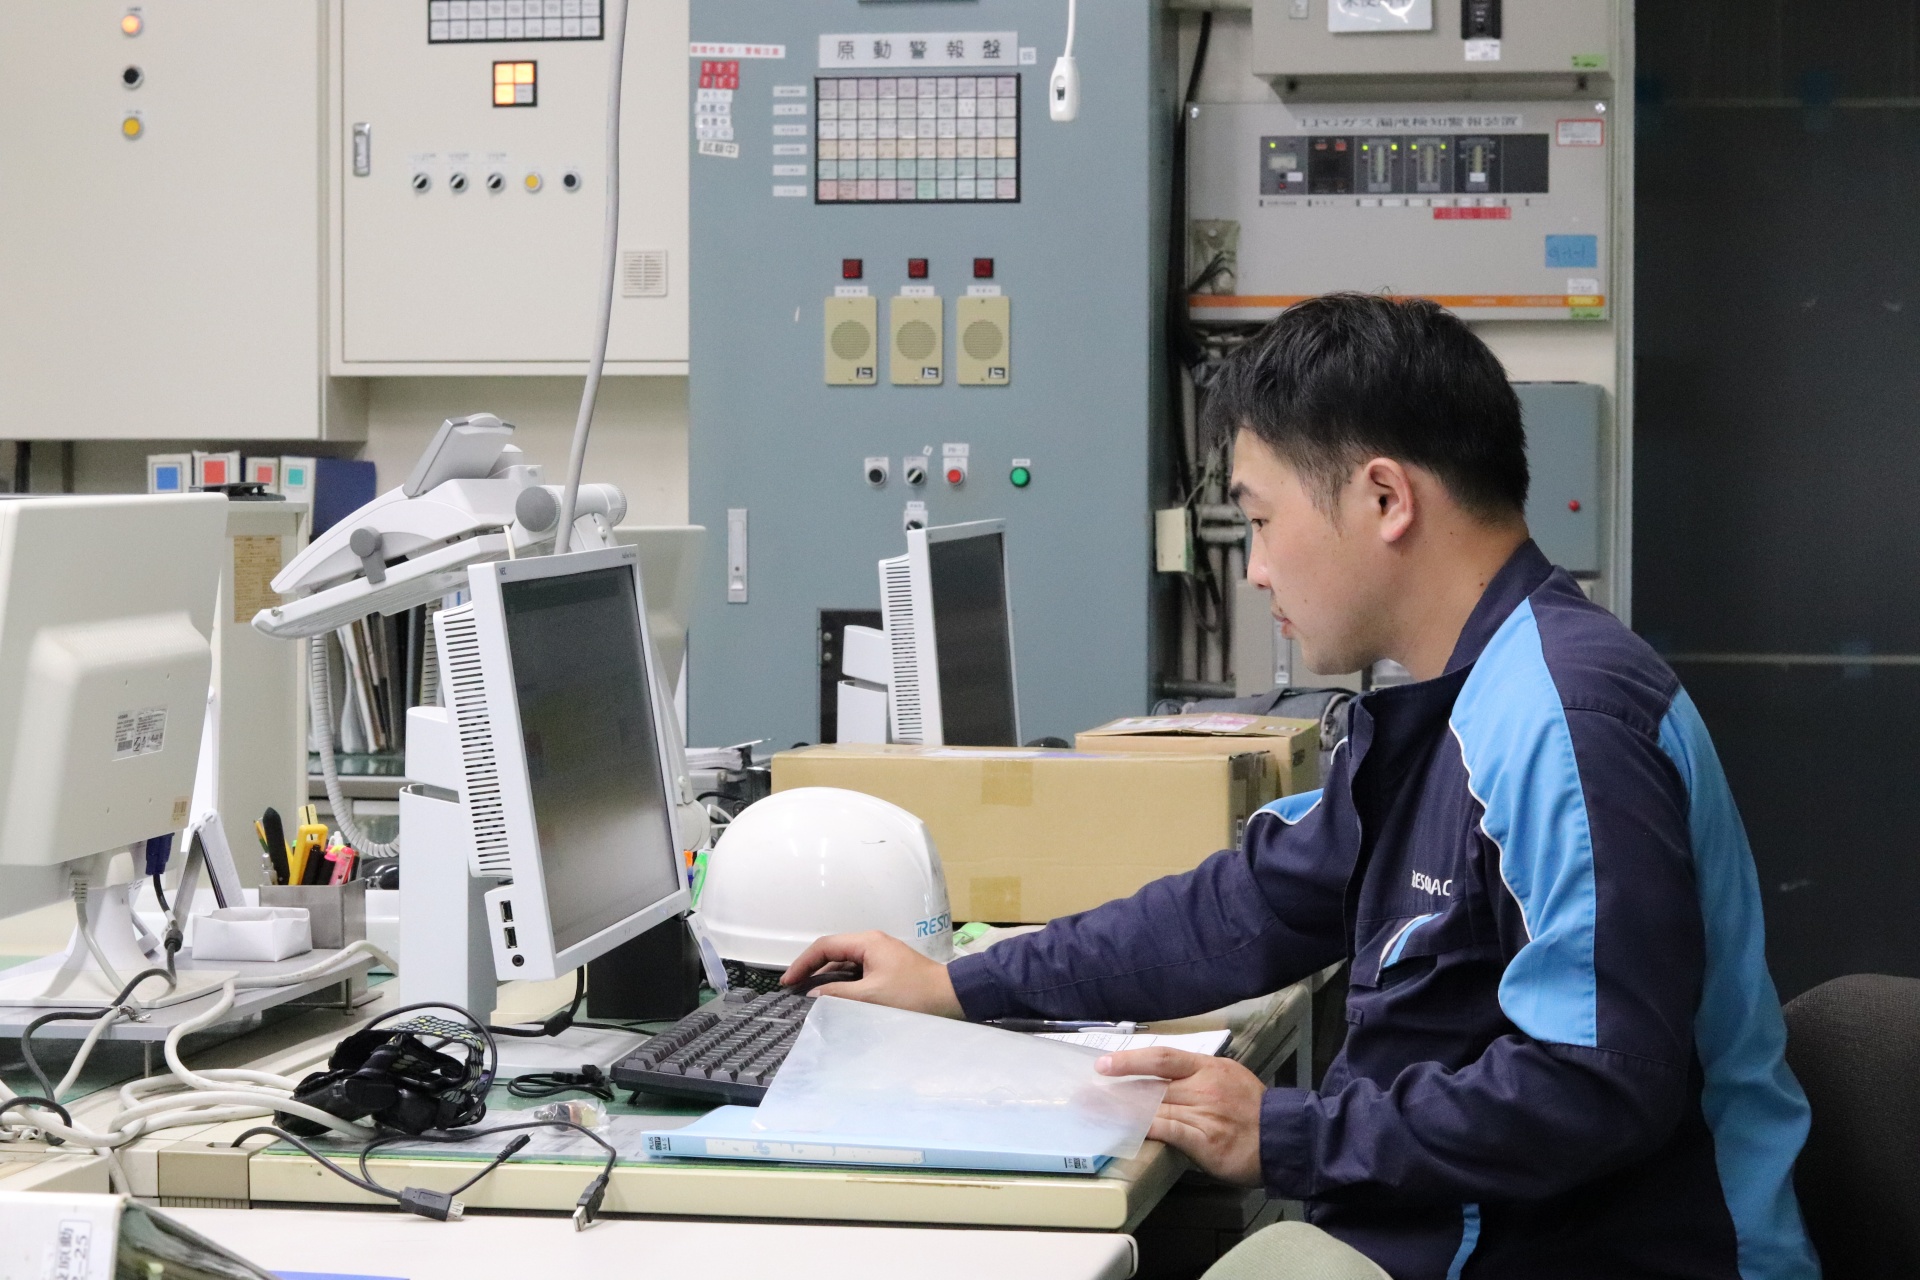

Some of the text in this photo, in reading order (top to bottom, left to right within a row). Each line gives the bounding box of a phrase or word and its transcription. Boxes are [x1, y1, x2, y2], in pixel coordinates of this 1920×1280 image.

[837, 39, 1002, 60] 原動警報盤
[916, 912, 951, 938] RESO
